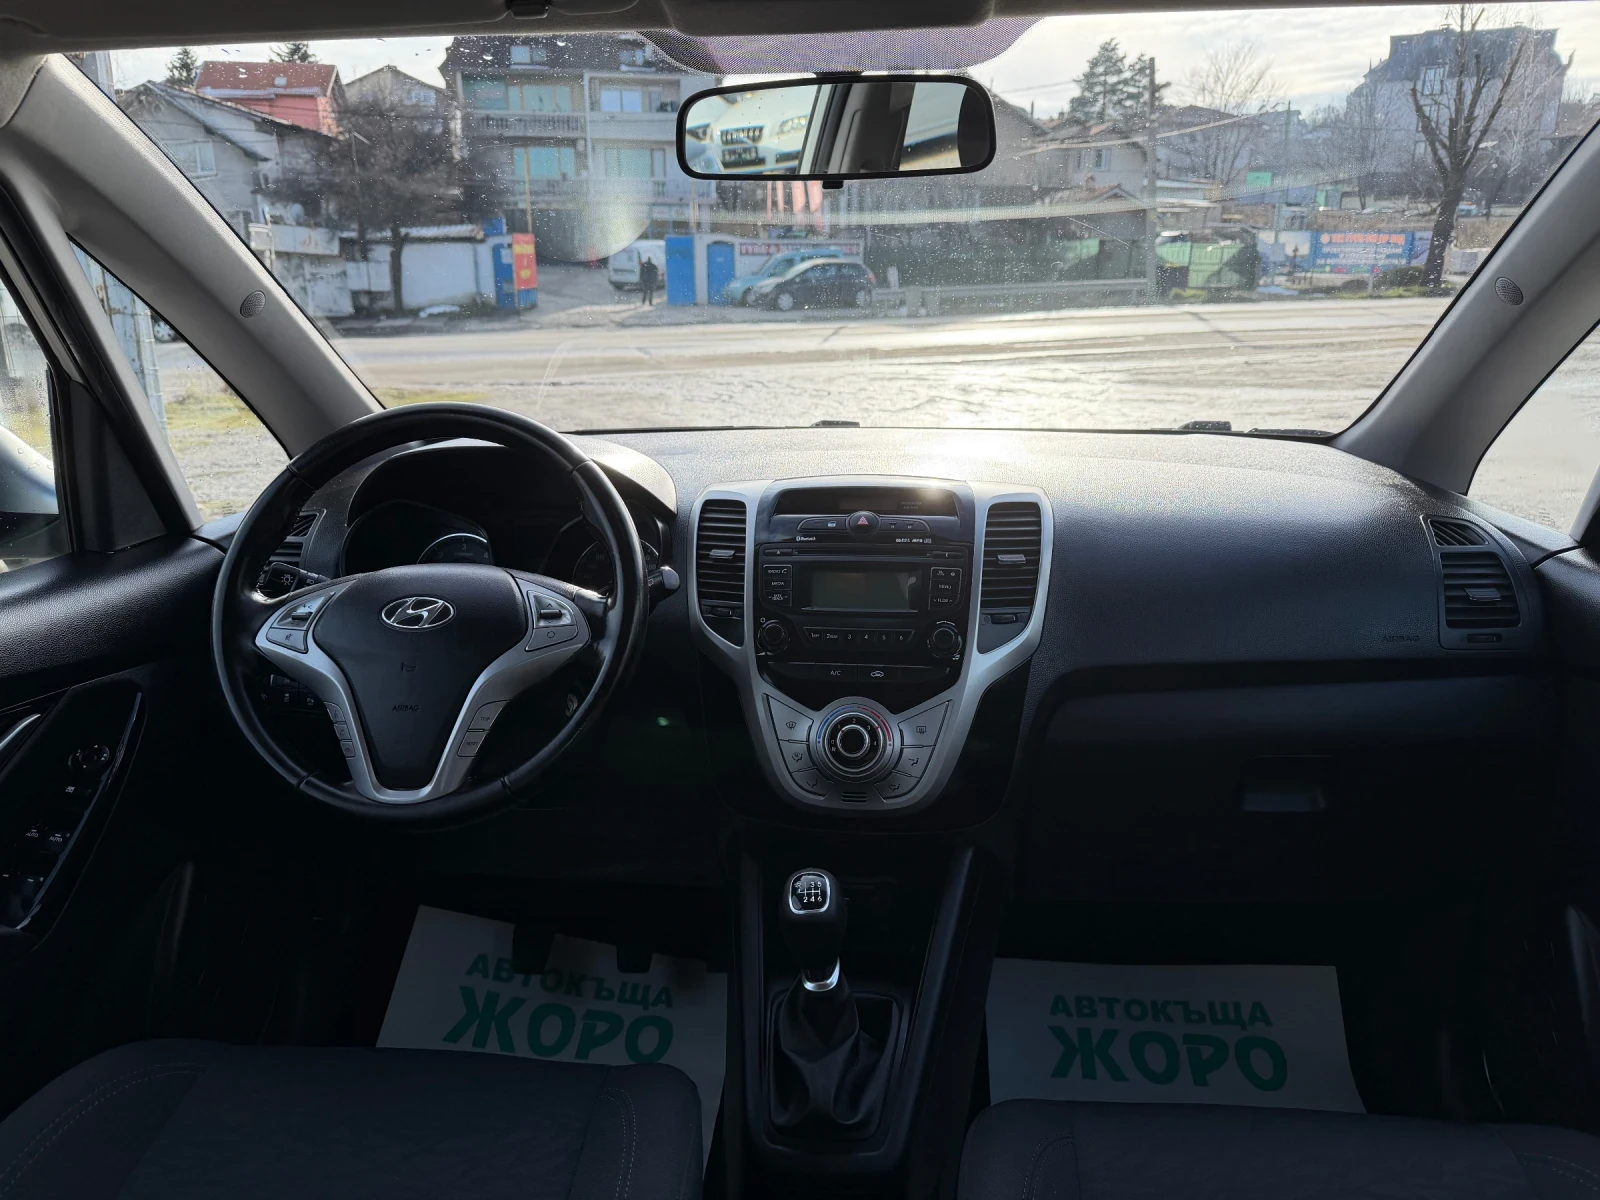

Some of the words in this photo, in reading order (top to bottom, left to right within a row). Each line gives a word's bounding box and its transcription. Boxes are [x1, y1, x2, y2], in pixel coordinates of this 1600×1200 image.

[1382, 635, 1420, 643] AIRBAG
[391, 704, 421, 712] AIRBAG
[442, 985, 674, 1064] ЖОРО
[1049, 994, 1274, 1031] АВТОКЪЩА
[1047, 1025, 1289, 1092] ЖОРО
